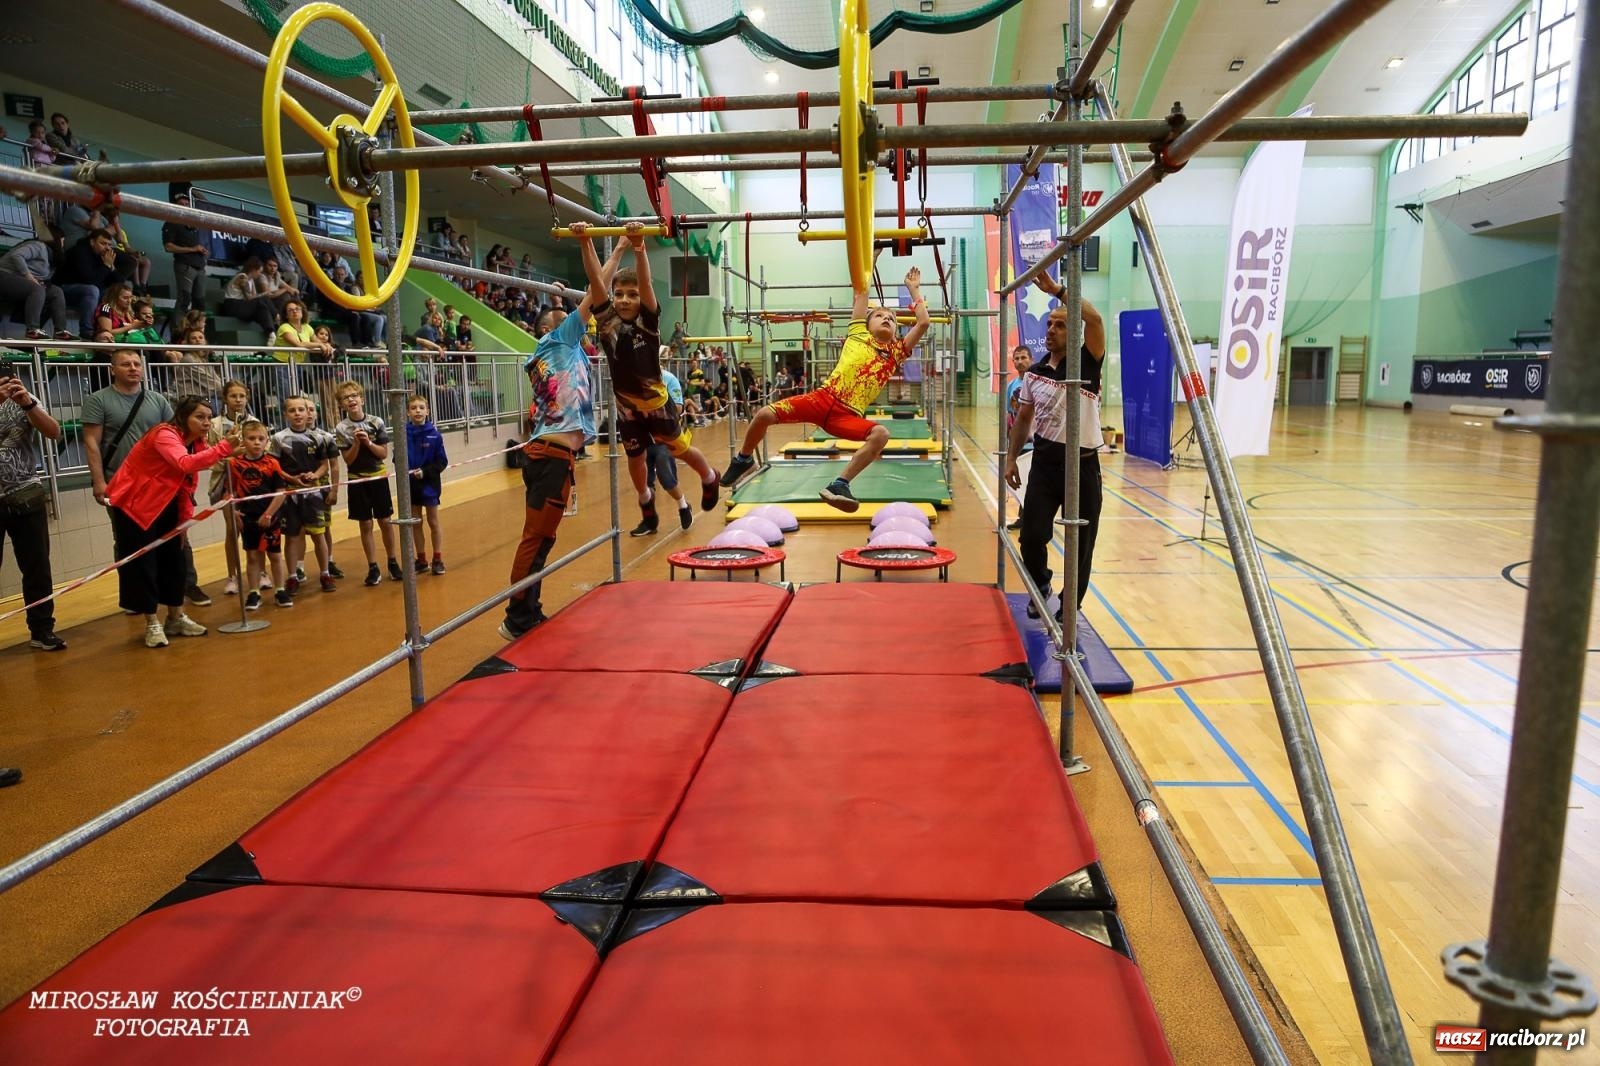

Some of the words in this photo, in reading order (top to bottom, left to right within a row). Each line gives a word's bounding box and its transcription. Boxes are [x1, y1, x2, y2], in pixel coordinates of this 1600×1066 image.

[507, 0, 543, 28] ORTU
[550, 20, 593, 79] REKREACJI
[16, 102, 34, 116] E
[1225, 227, 1273, 381] OSiR
[1268, 226, 1288, 321] RACIBÓRZ
[1485, 368, 1509, 383] OSiR
